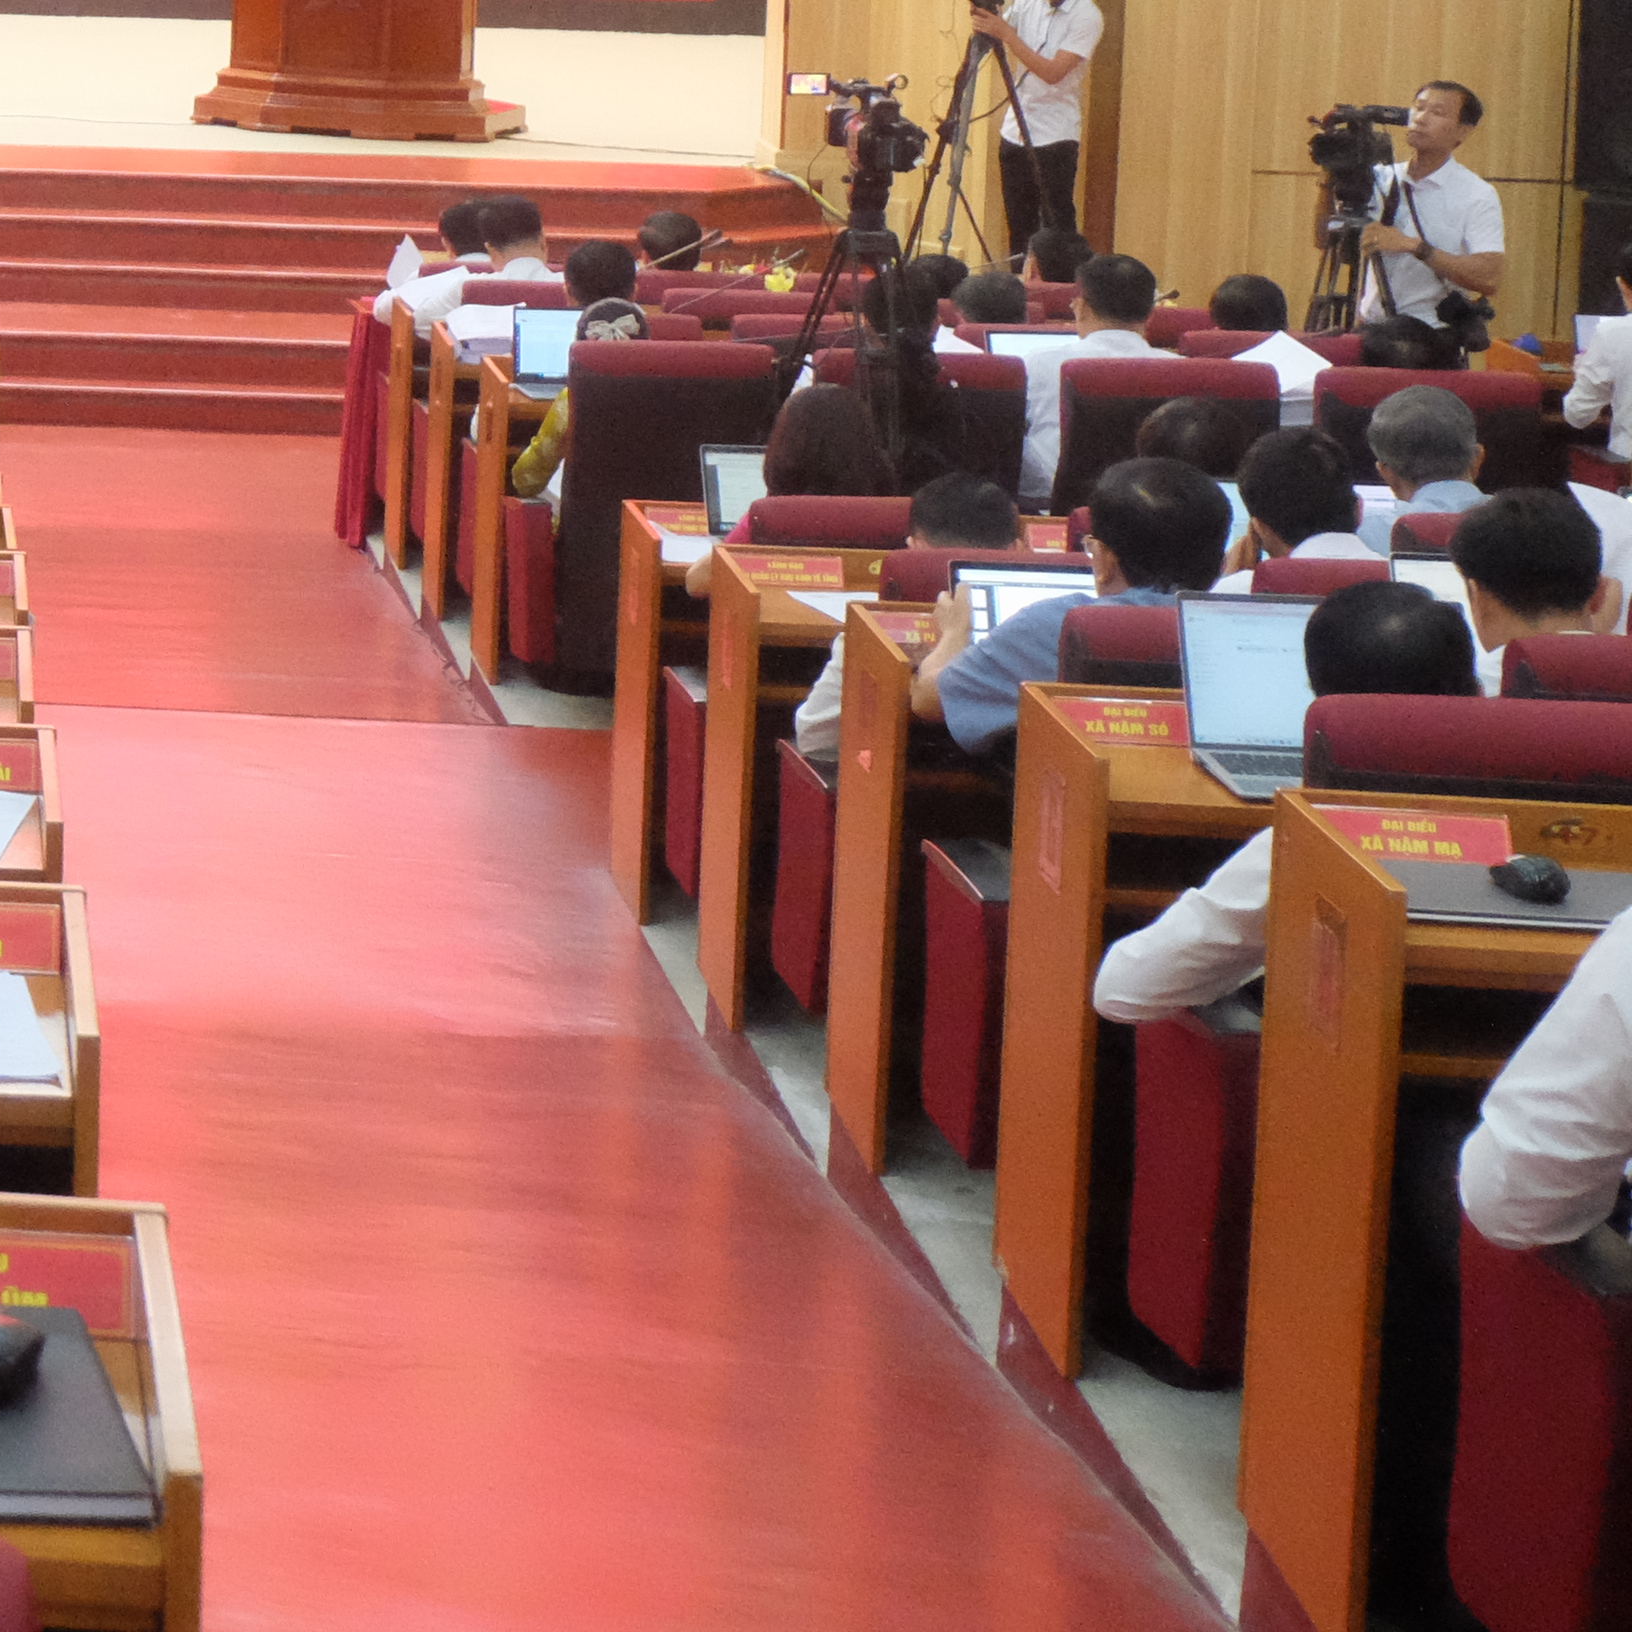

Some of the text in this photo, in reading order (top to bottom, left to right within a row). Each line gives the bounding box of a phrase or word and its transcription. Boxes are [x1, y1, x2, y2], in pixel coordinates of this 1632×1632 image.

[1103, 706, 1147, 718] ĐẠI BIỂU
[1085, 719, 1105, 733] XÃ
[1109, 719, 1144, 735] NẬM
[1381, 817, 1437, 834] ĐẠI BIỂU
[1360, 833, 1384, 852] XÃ
